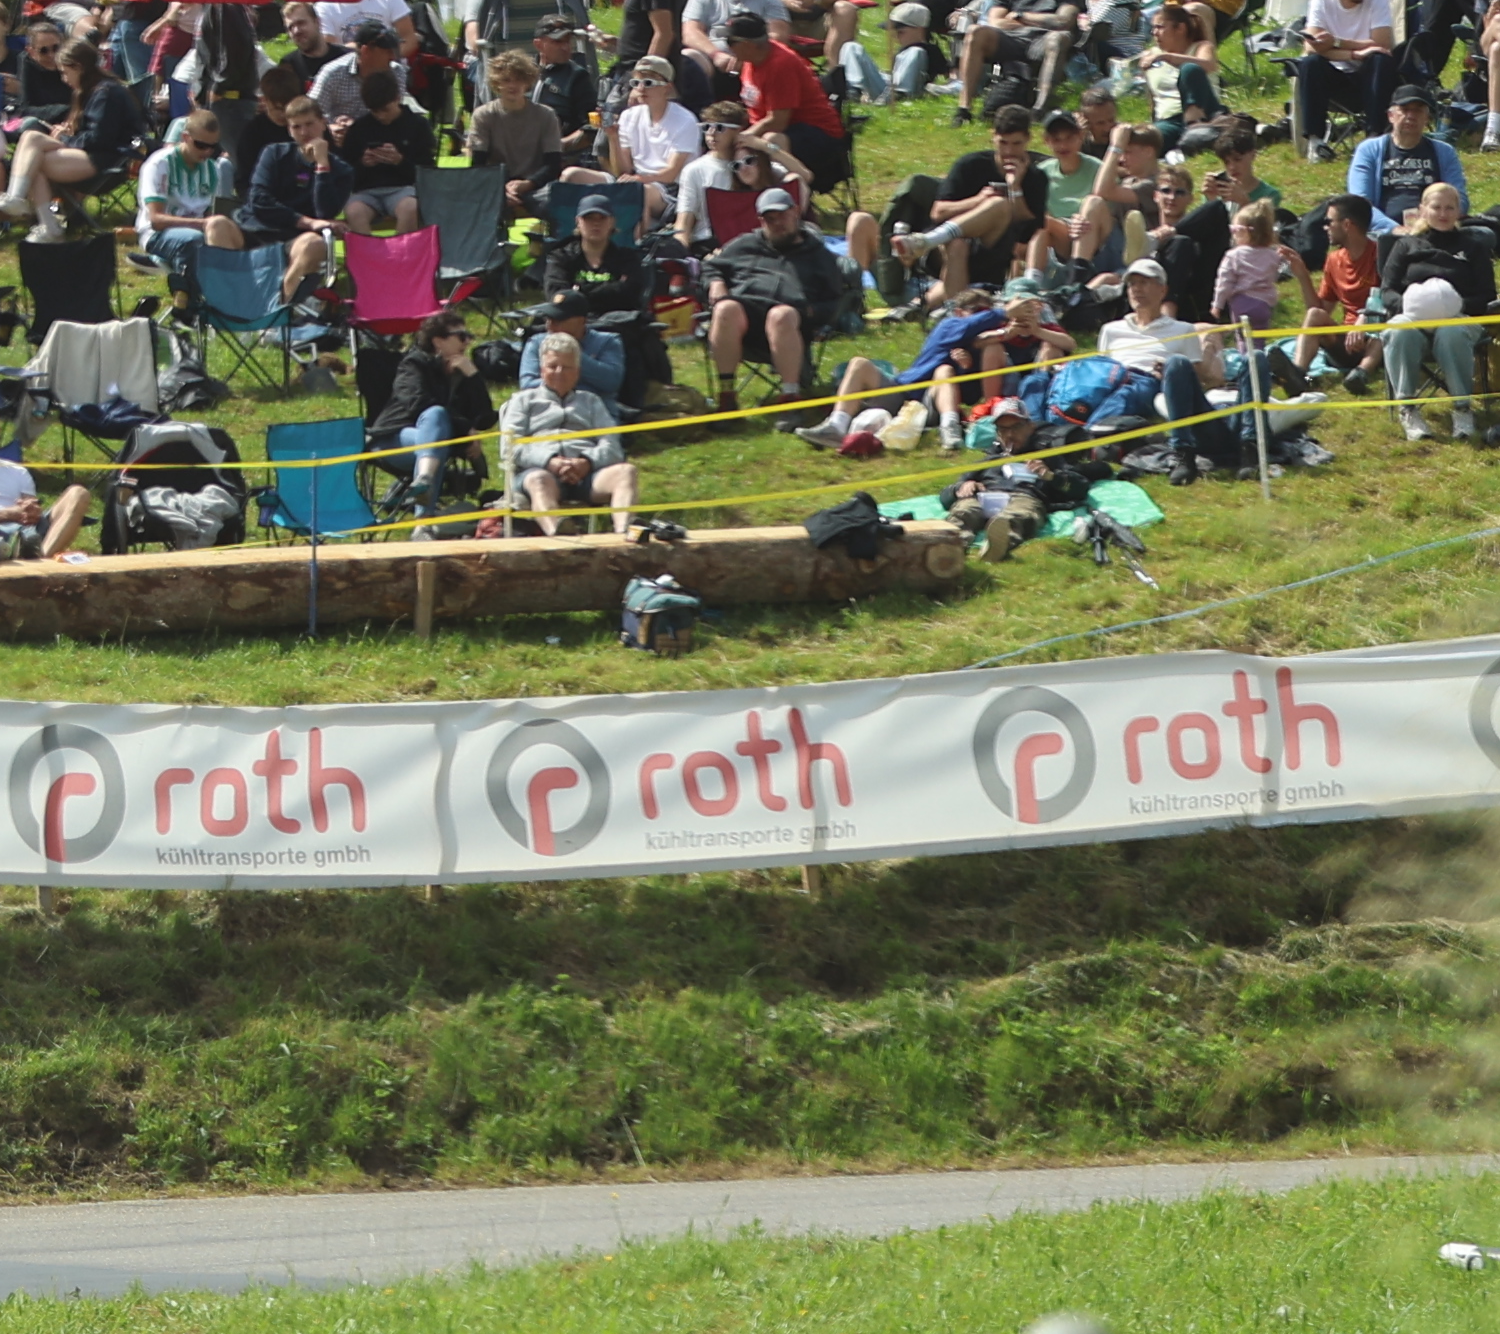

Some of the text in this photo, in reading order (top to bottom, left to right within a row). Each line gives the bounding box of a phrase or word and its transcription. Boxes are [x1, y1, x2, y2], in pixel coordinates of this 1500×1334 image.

[1122, 666, 1341, 785] roth
[154, 726, 366, 835] roth
[638, 706, 853, 820] roth
[1128, 779, 1345, 816] kühltransporte gmbh
[155, 844, 372, 870] kühltransporte gmbh
[644, 819, 858, 851] kühltransporte gmbh
